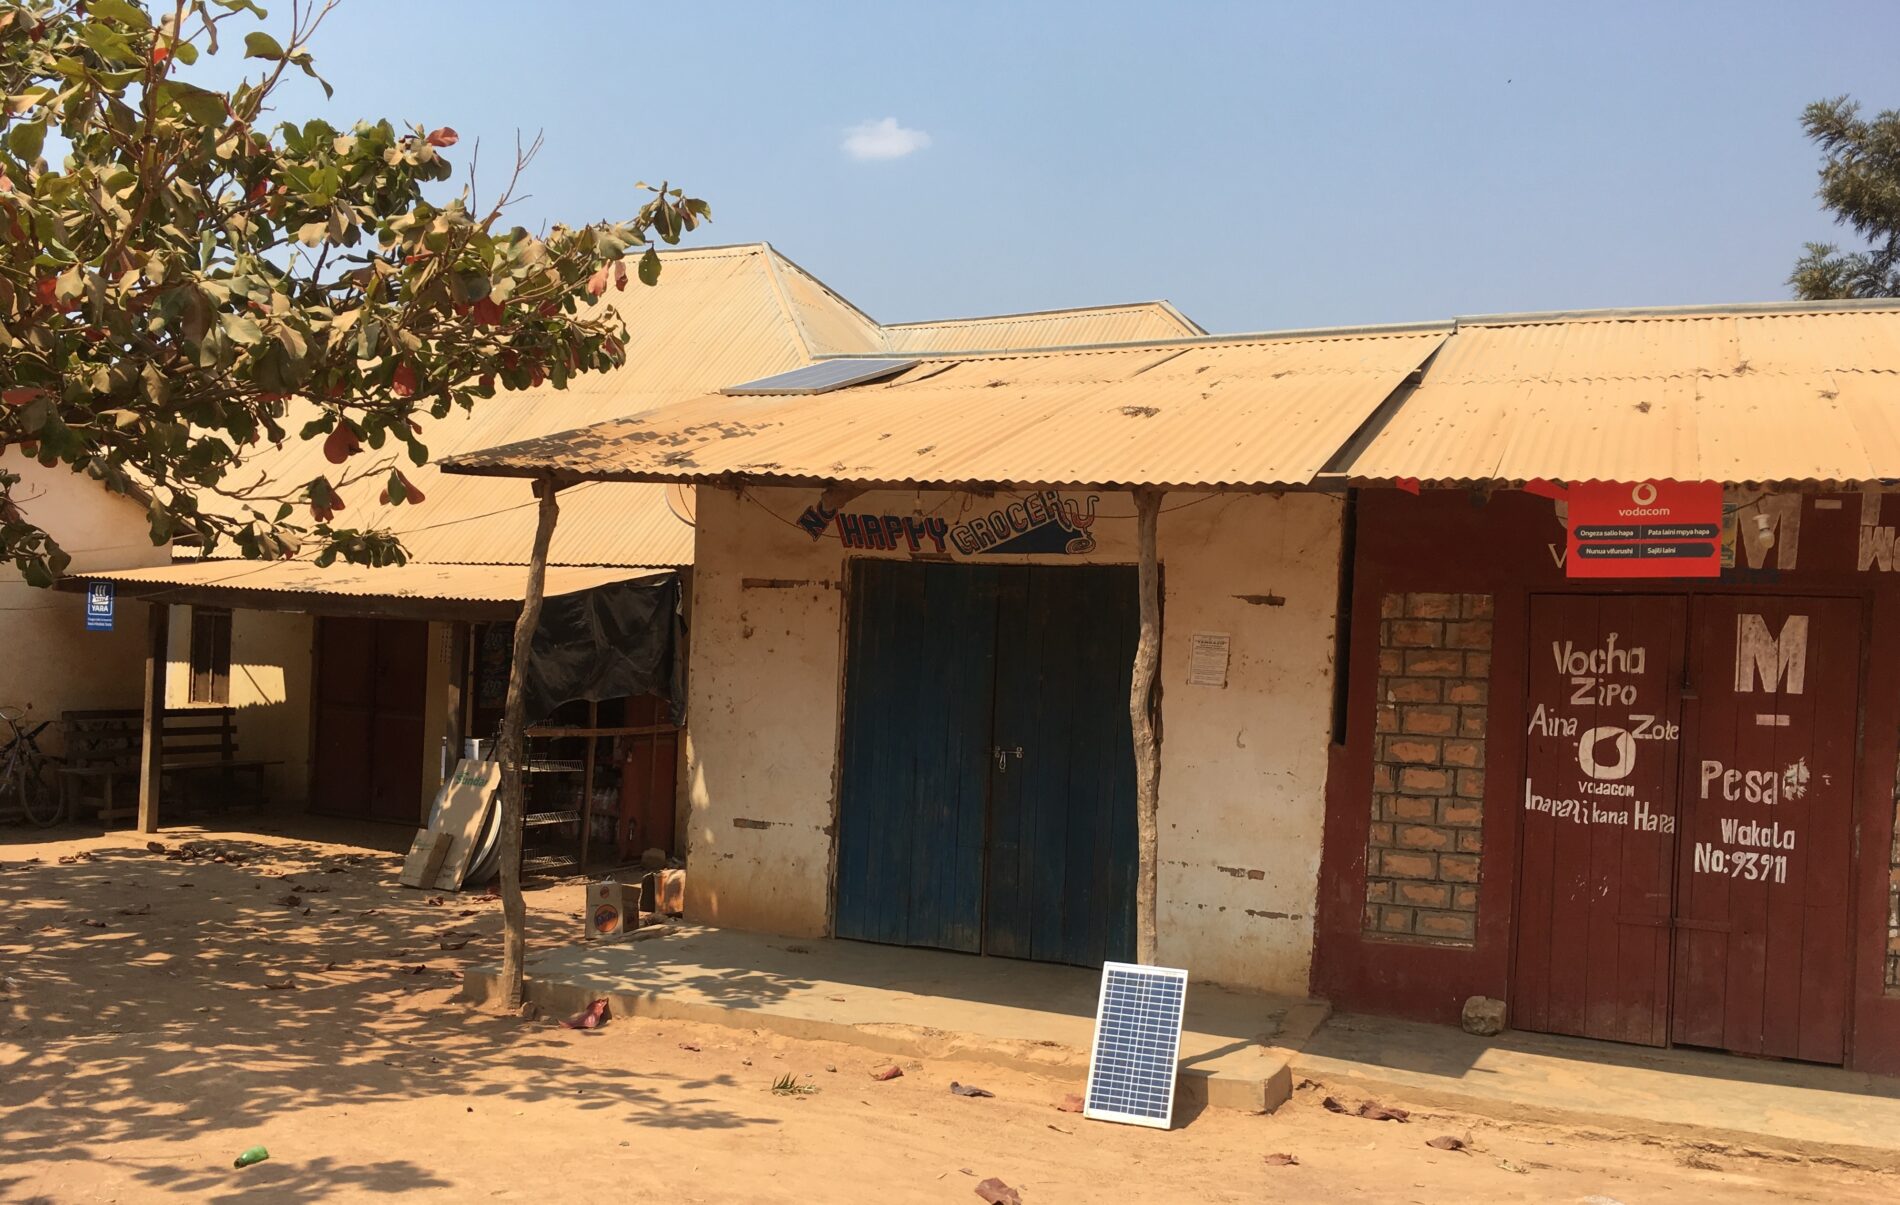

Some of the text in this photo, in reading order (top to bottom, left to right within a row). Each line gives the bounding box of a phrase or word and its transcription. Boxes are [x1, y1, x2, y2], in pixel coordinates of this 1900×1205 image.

[835, 512, 949, 553] HAPPY
[950, 489, 1100, 556] GROCERY
[1618, 506, 1670, 517] vodacom
[1580, 529, 1603, 538] Ongeza
[1619, 529, 1634, 537] hapa
[1676, 528, 1694, 537] mpya
[1694, 528, 1710, 536] hapa
[91, 604, 108, 612] YARA
[1552, 632, 1646, 676] Vocha
[1734, 613, 1809, 695] M
[1528, 703, 1578, 737] Aina
[1700, 760, 1778, 805] Pesa
[1721, 818, 1795, 850] Wakala
